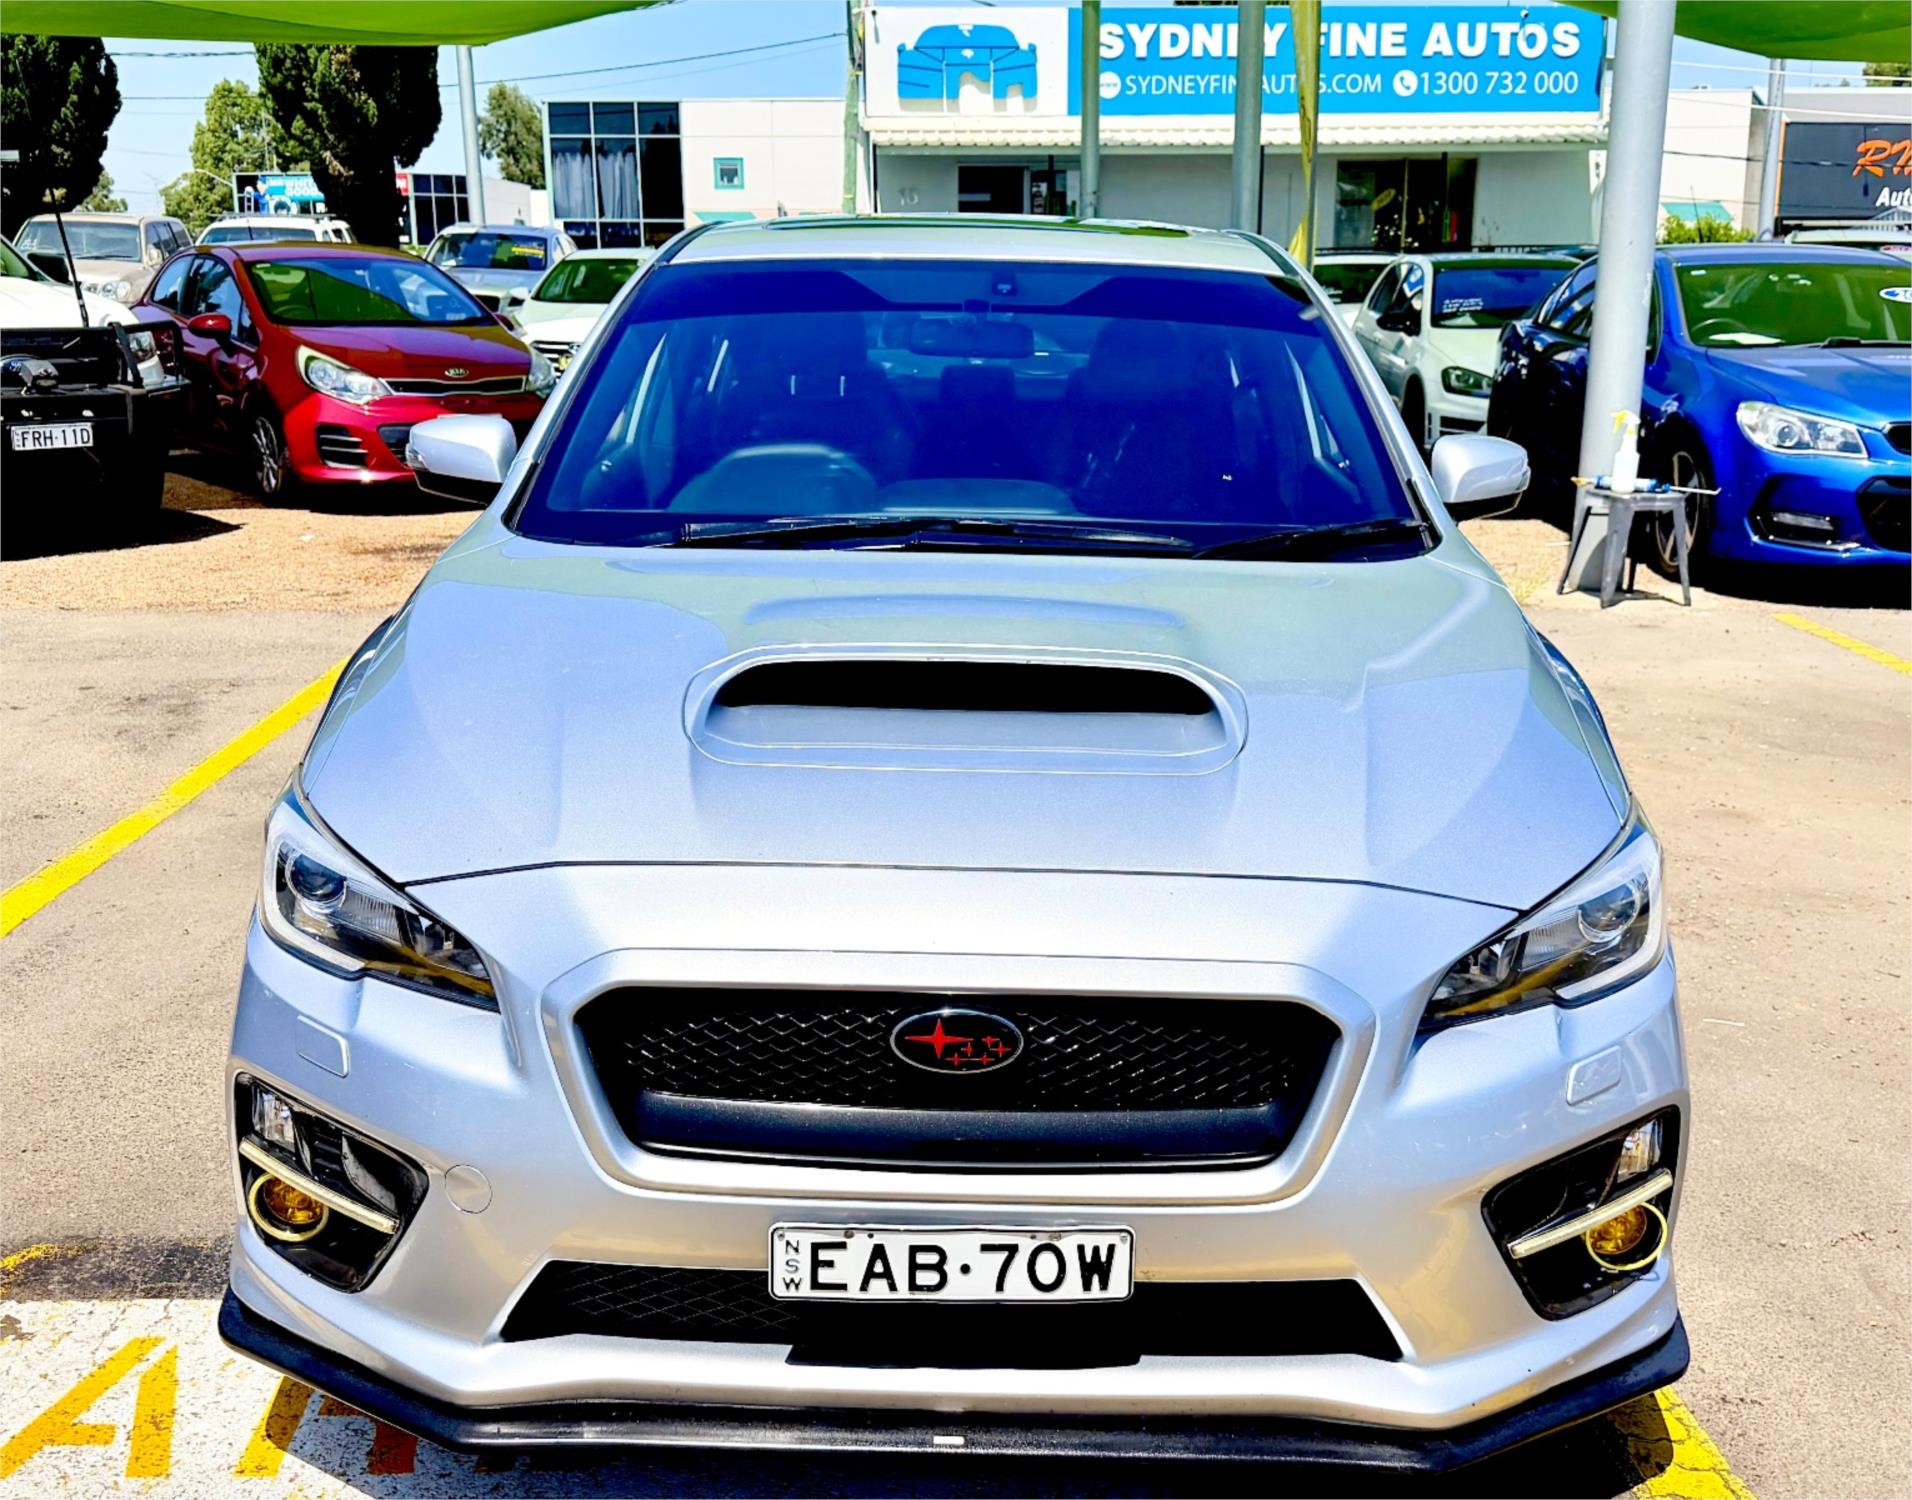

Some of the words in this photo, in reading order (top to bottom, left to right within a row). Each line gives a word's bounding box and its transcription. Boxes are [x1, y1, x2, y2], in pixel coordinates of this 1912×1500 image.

[1422, 22, 1580, 58] AUTOS
[1125, 74, 1382, 95] SYDNEYFINAUTS.COM
[1420, 71, 1478, 94] 1300
[1486, 71, 1527, 94] 732
[1534, 71, 1579, 94] 000
[1875, 186, 1912, 207] Aut
[783, 1240, 802, 1292] NSW
